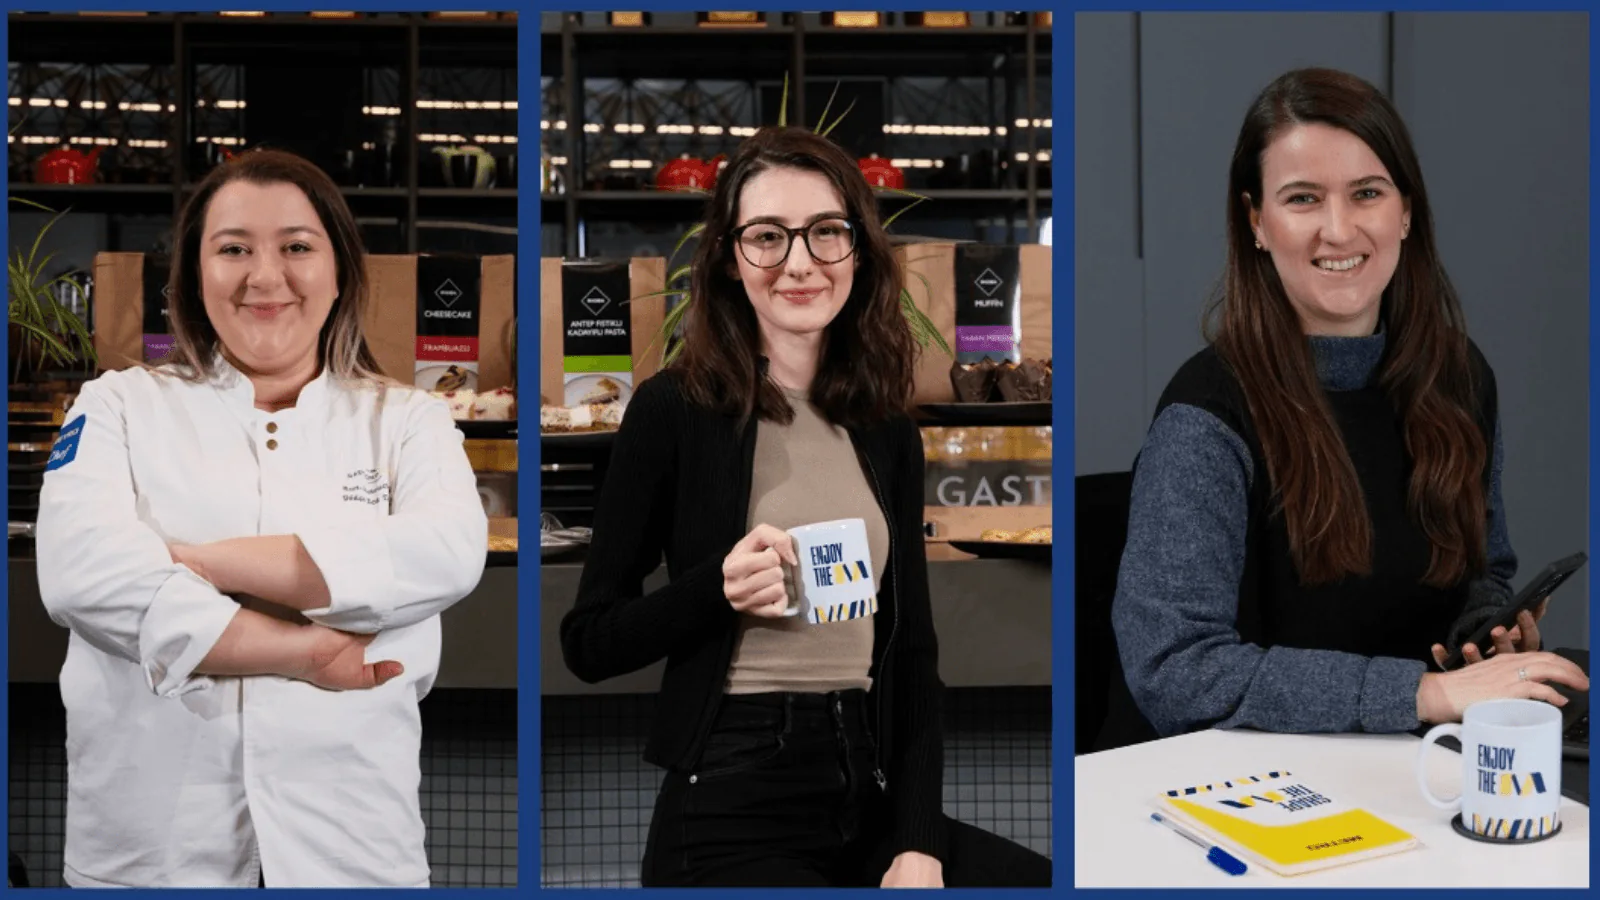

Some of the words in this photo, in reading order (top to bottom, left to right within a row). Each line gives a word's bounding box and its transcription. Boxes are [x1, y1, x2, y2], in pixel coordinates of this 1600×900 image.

[424, 310, 472, 319] CHEESECAKE
[571, 320, 594, 328] ANTEP
[937, 475, 1051, 507] GAST
[810, 543, 843, 566] ENJOY
[813, 566, 834, 588] THE
[1478, 744, 1515, 771] ENJOY
[1478, 769, 1496, 795] THE
